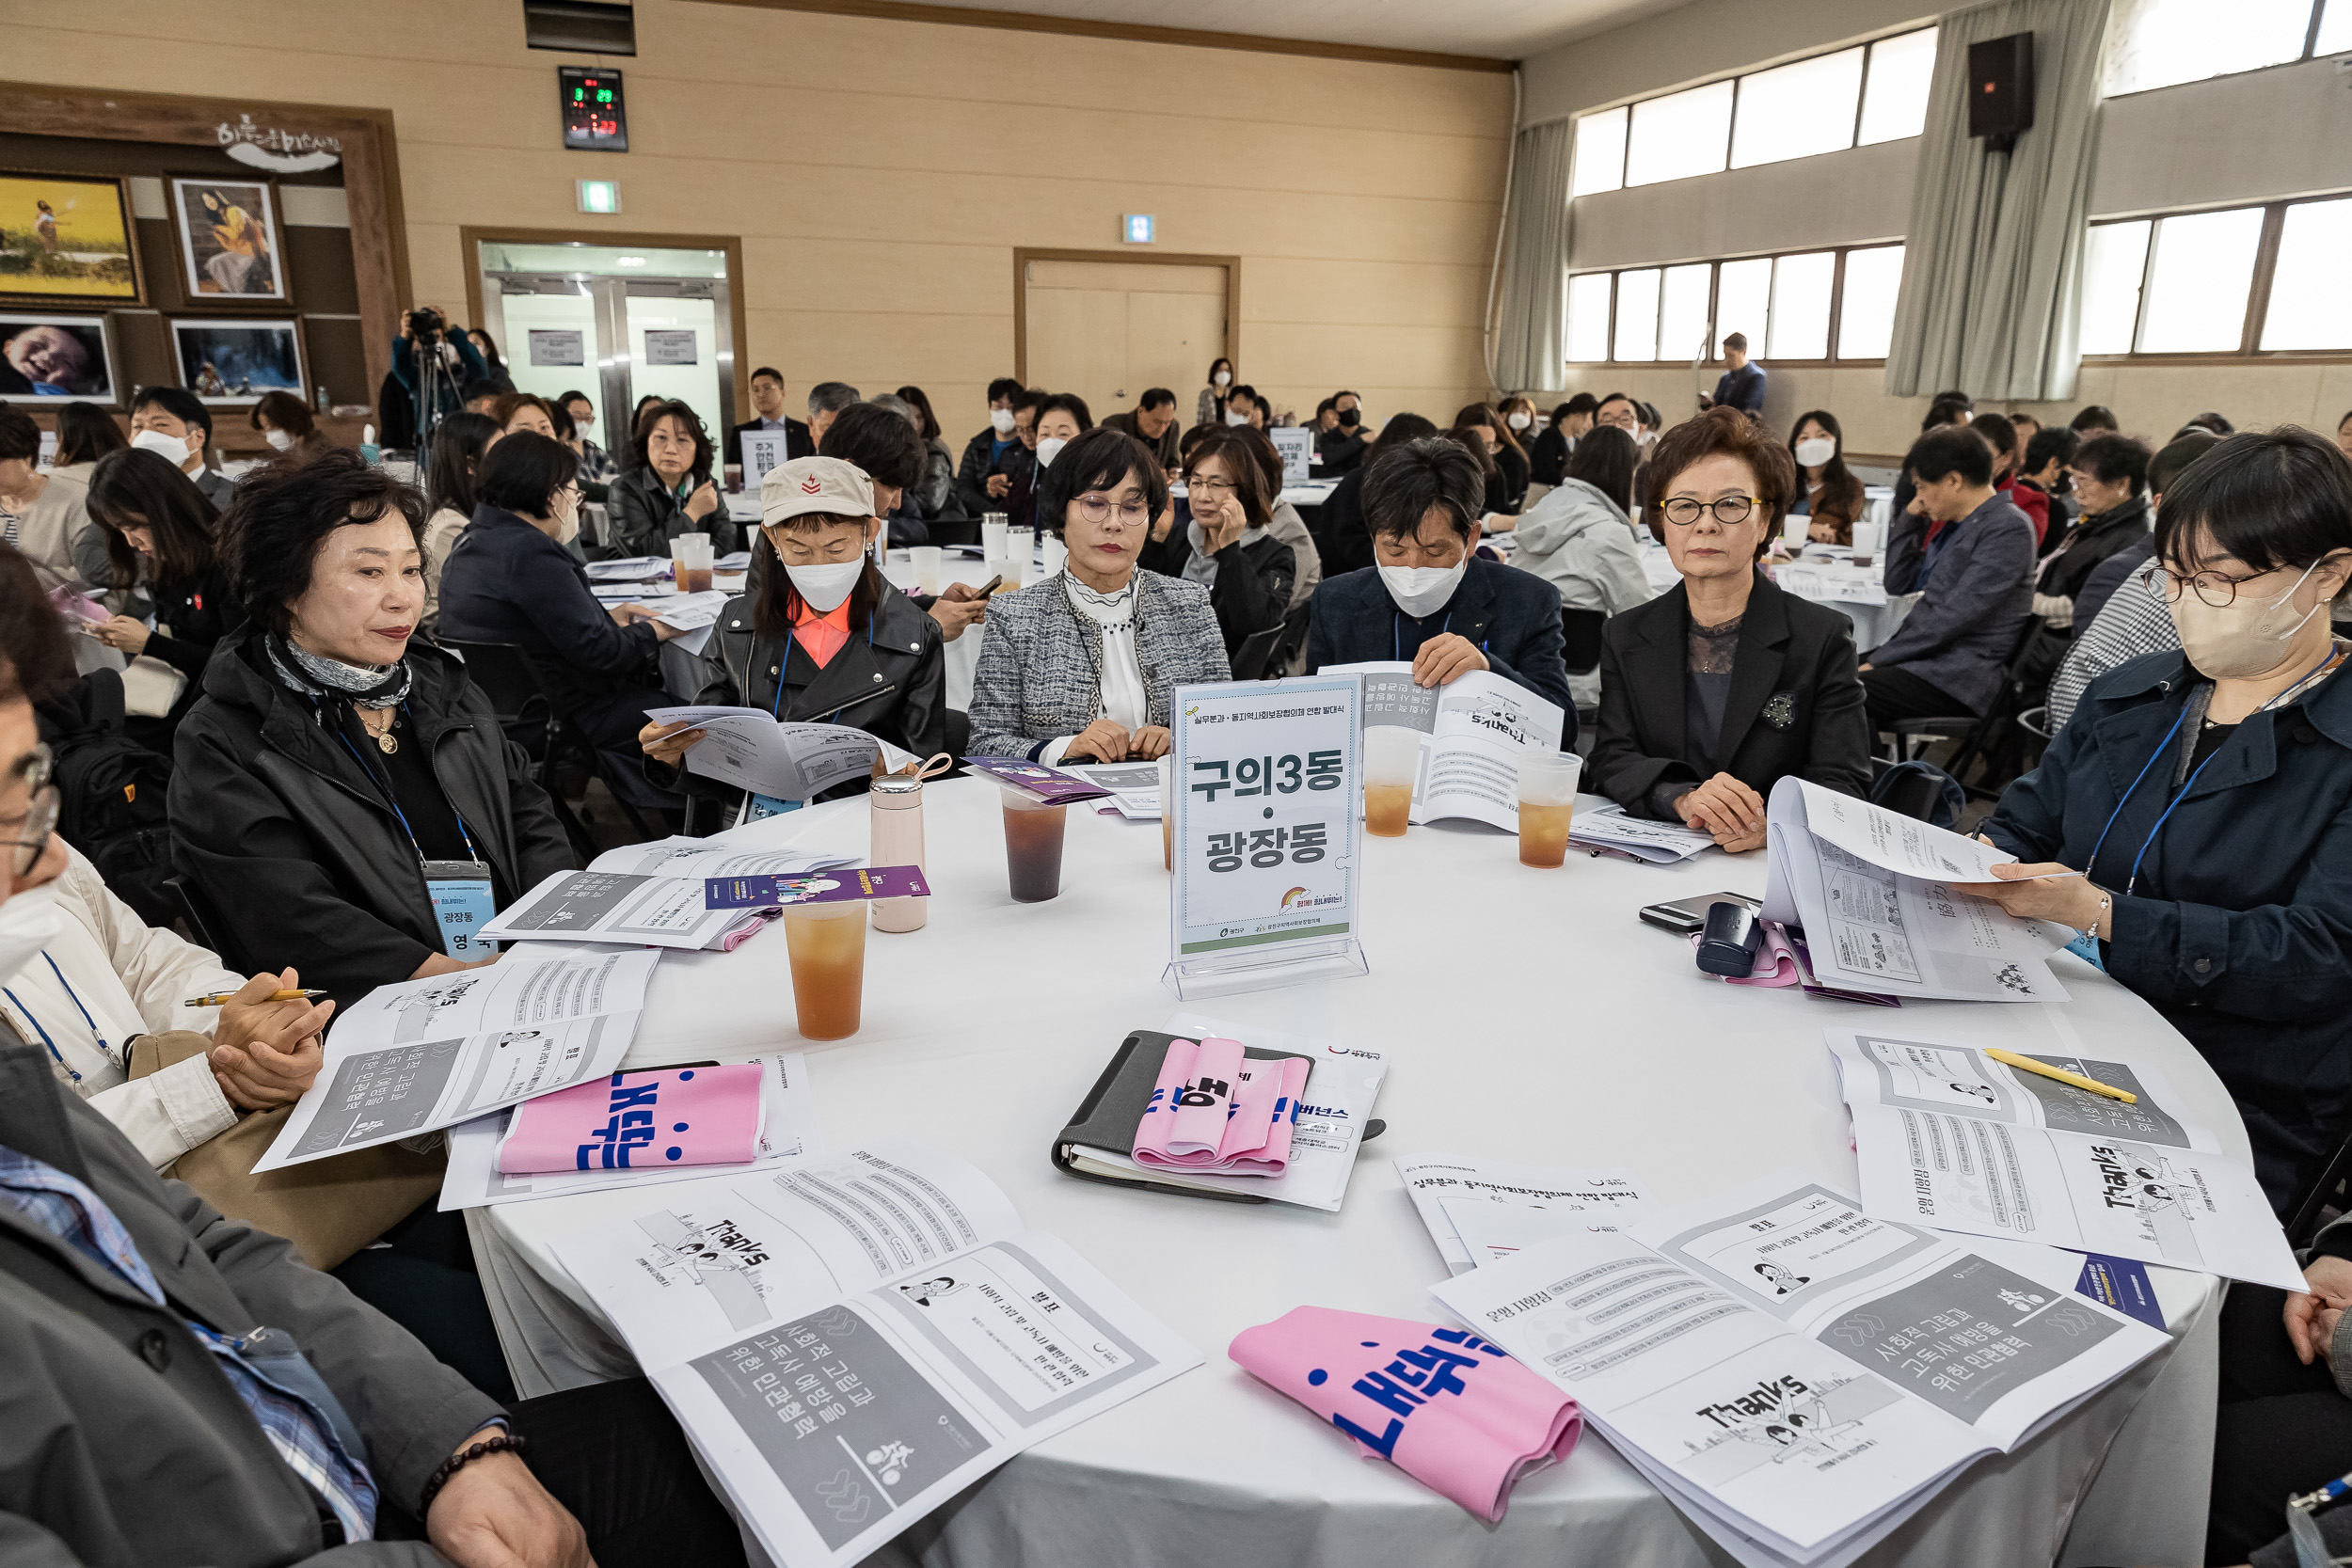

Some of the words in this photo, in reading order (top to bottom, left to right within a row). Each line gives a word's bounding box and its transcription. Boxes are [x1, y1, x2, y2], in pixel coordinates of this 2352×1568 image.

[1194, 715, 1226, 725] 실무분과
[1231, 708, 1305, 721] 동지역사회보장협의체
[1306, 707, 1321, 716] 연합
[1322, 705, 1344, 715] 발대식
[1398, 704, 1431, 716] 사회적
[1400, 694, 1432, 705] 고독사
[1471, 715, 1527, 746] Thanks
[1191, 750, 1343, 802] 구의3동
[1207, 823, 1327, 873] 광장동
[444, 912, 473, 923] 광장동
[2072, 1100, 2109, 1126] 사회적
[2097, 1104, 2137, 1131] 고독사
[2126, 1113, 2163, 1134] 위한
[1412, 1178, 1458, 1189] 실무분과
[1576, 1192, 1600, 1201] 연합
[1913, 1168, 1931, 1197] 지향점
[2090, 1145, 2136, 1209] Thanks
[1918, 1198, 1935, 1216] 운영
[706, 1220, 771, 1266] Thanks
[1486, 1305, 1517, 1324] 운영
[1510, 1291, 1554, 1315] 지향점
[1875, 1325, 1931, 1362] 사회적
[1920, 1307, 1974, 1334] 고립과
[1900, 1341, 1960, 1379] 고독사
[1948, 1321, 2004, 1348] 예방을
[754, 1335, 805, 1375] 고독사
[795, 1373, 848, 1424] 예방을
[783, 1324, 834, 1362] 사회적
[822, 1360, 877, 1408] 고립과
[1931, 1362, 1977, 1393] 위한
[1963, 1335, 2033, 1370] 민관협력
[726, 1346, 764, 1374] 위한
[753, 1372, 819, 1440] 민관협력
[1695, 1375, 1808, 1429] Thanks
